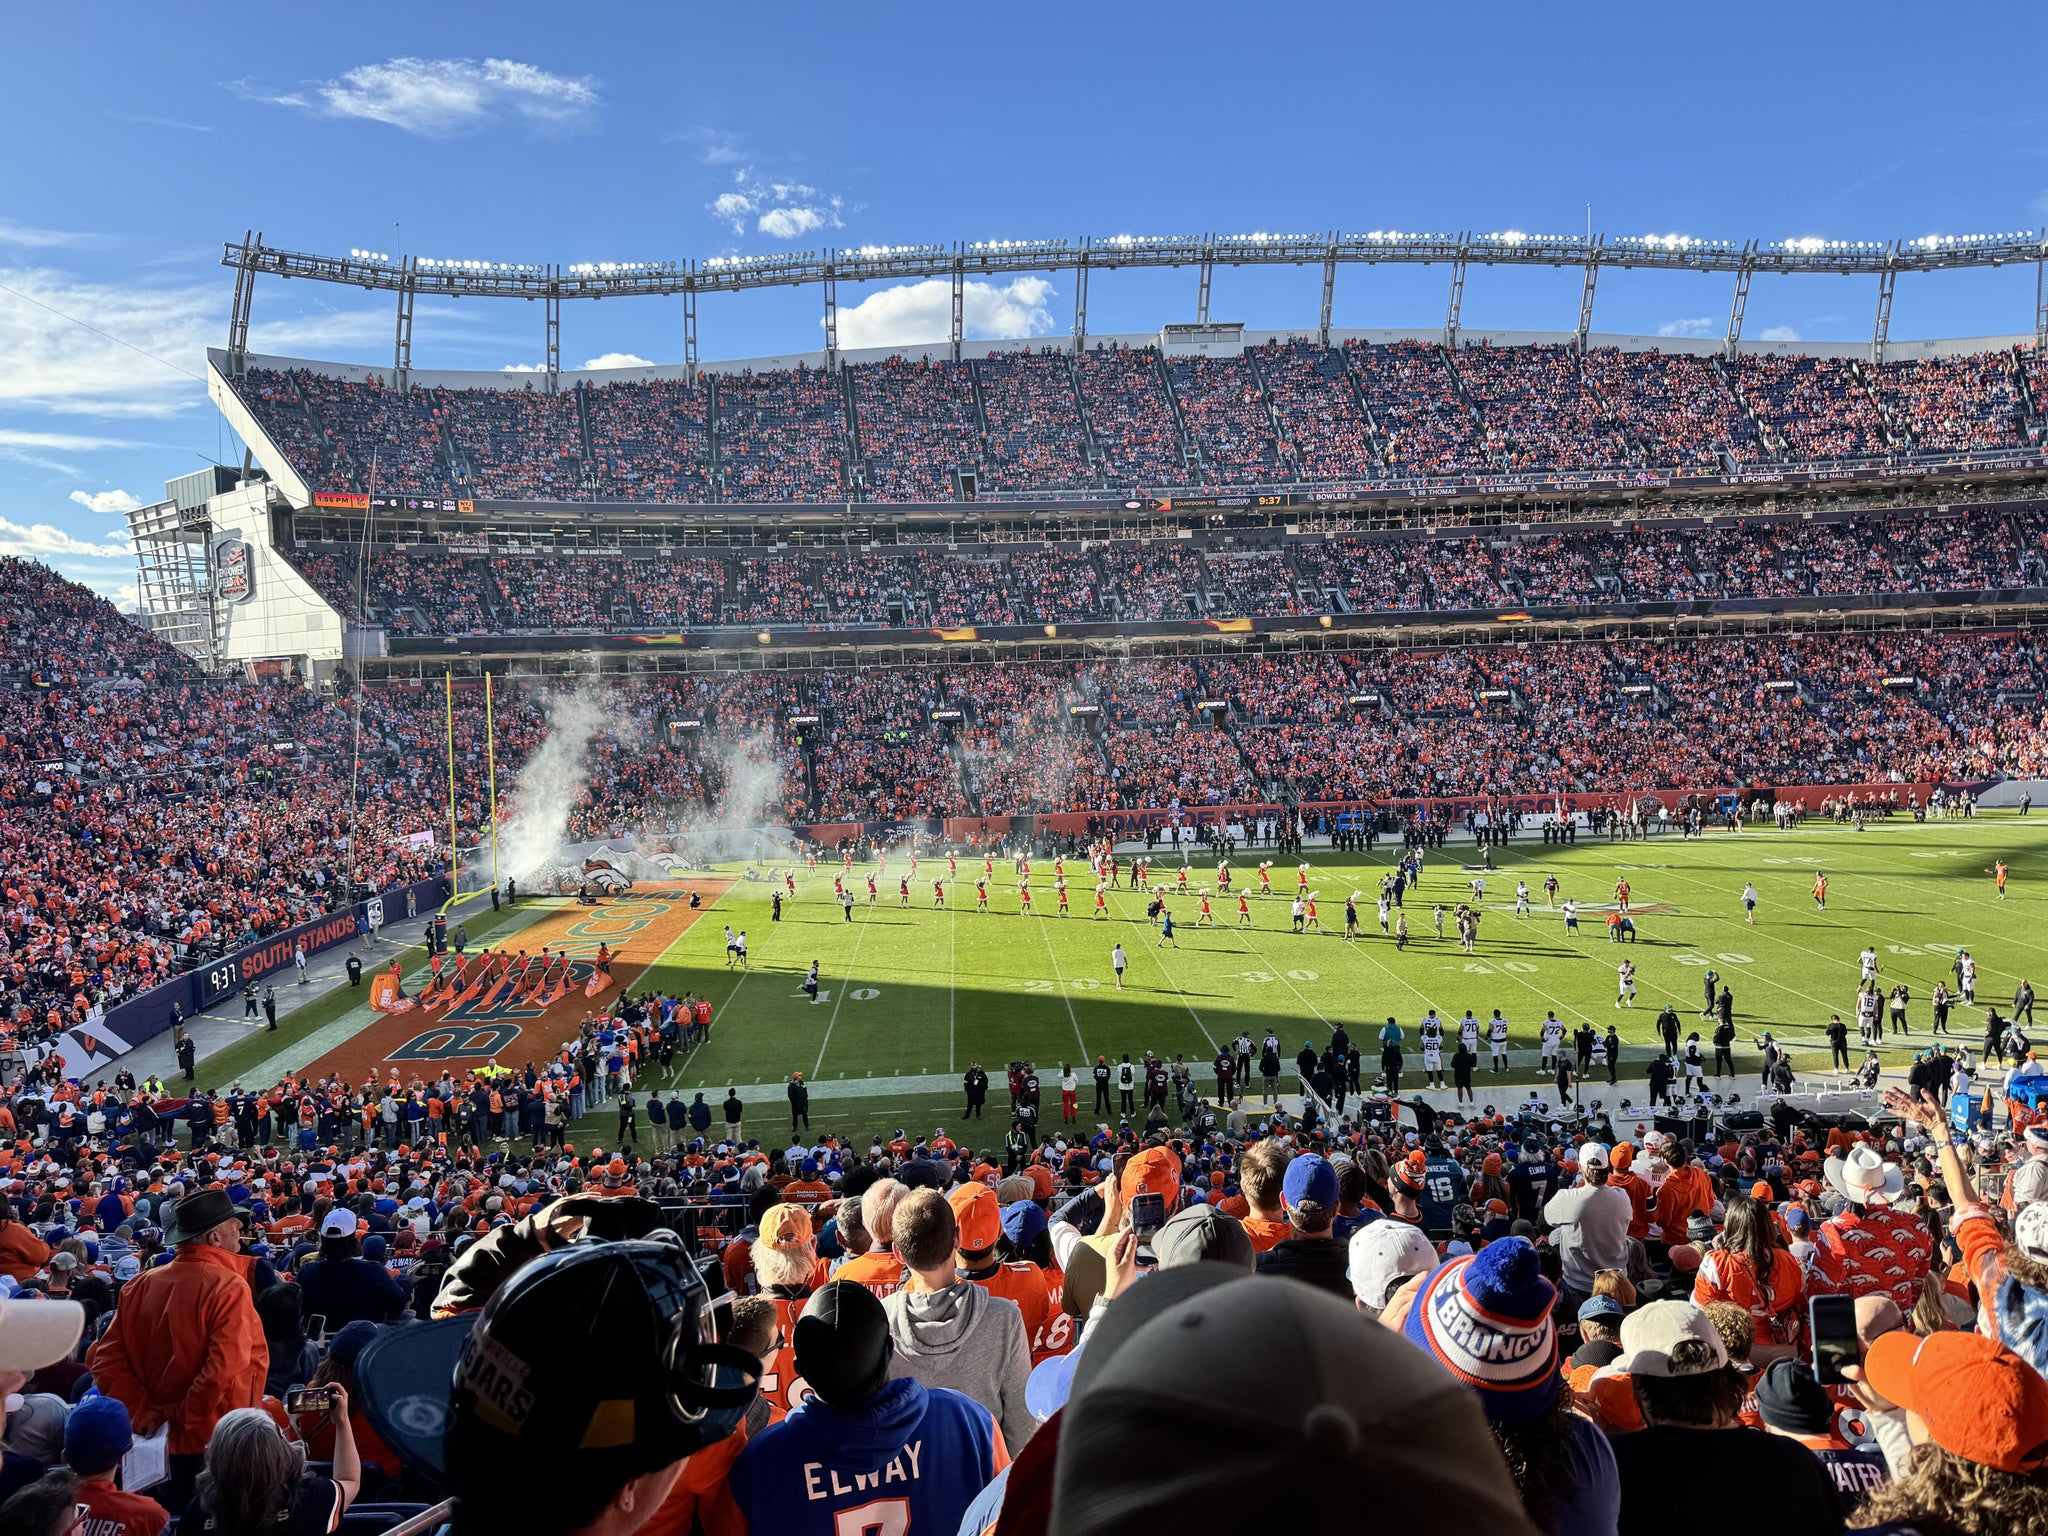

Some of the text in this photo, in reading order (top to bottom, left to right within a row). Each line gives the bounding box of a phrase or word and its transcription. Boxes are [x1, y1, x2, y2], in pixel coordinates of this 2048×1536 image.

[1900, 467, 1927, 475] SHARPE
[1742, 475, 1783, 483] UPCHURCH
[1316, 492, 1348, 500] BOWLEN
[1428, 488, 1457, 496] THOMAS
[390, 499, 398, 507] 6
[423, 501, 435, 509] 22
[1258, 496, 1282, 506] 9:37
[241, 914, 357, 980] SOUTH STANDS
[1669, 952, 1755, 966] 50
[1463, 961, 1539, 975] 40
[211, 963, 237, 991] 9:37
[1241, 969, 1320, 983] 30
[1023, 978, 1101, 993] 20
[1864, 998, 1874, 1007] 16
[1465, 1023, 1477, 1032] 70
[1549, 1026, 1561, 1035] 72
[1425, 1042, 1439, 1051] 60
[238, 1105, 245, 1115] 7
[1764, 1156, 1776, 1167] 10
[1528, 1165, 1547, 1176] ELWAY
[1651, 1174, 1662, 1182] NIX
[1427, 1176, 1454, 1203] 16
[1530, 1179, 1548, 1209] 7
[391, 1257, 414, 1267] ELWAY
[804, 1440, 922, 1501] ELWAY
